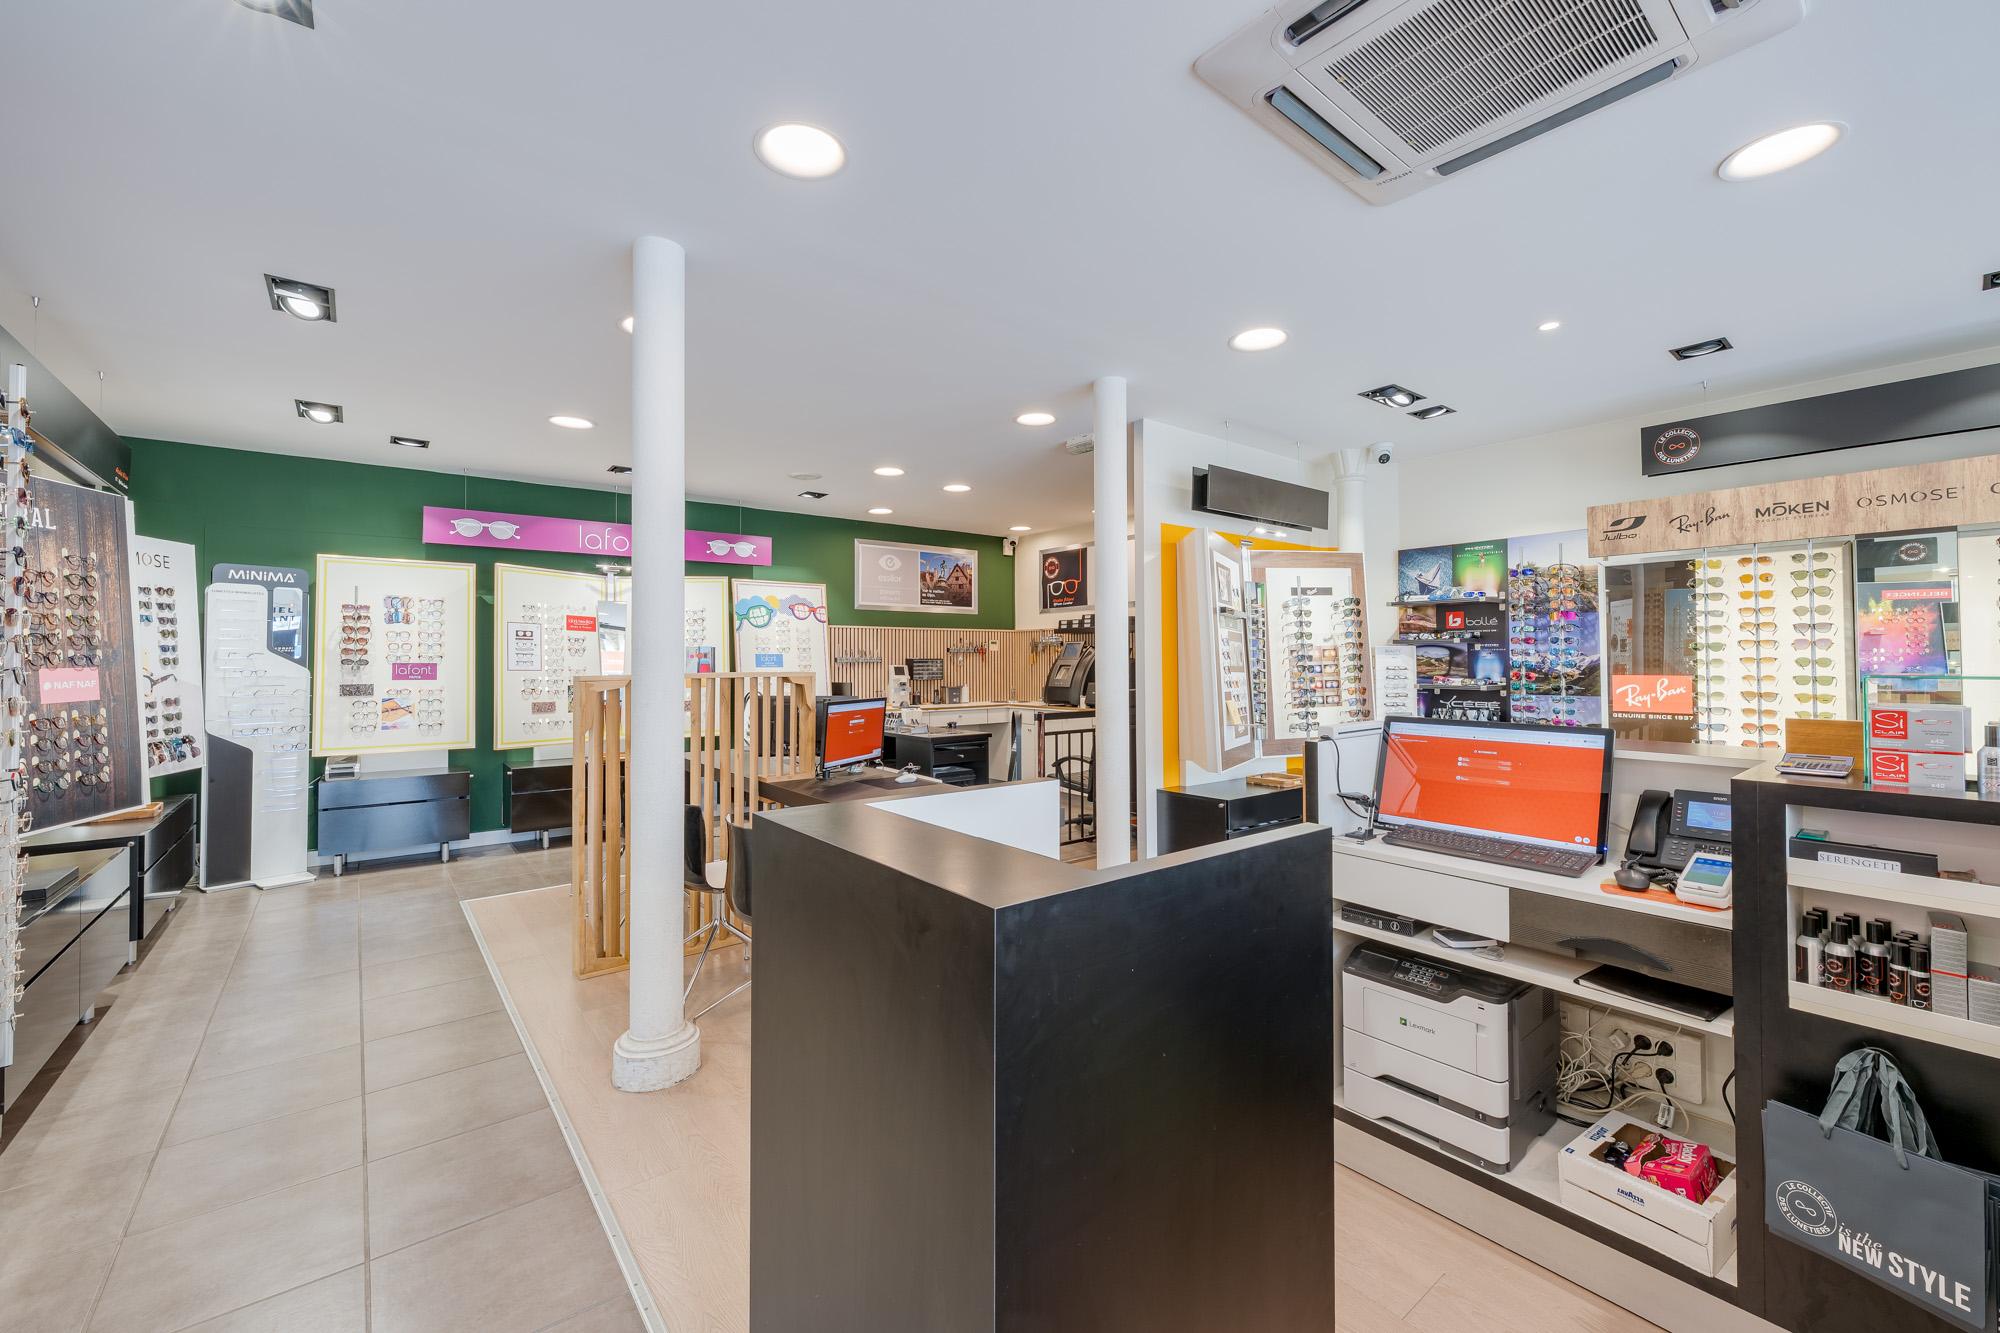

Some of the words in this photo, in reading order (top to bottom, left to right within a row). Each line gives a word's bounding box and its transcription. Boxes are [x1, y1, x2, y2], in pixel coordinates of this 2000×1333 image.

[1658, 436, 1666, 444] LE
[1665, 429, 1697, 439] COLLECTIF
[1657, 451, 1667, 461] DES
[1666, 446, 1698, 463] LUNETIERS
[1857, 487, 1958, 508] OSMOSE
[1669, 506, 1730, 533] Ray-Ban
[1600, 532, 1638, 542] Julbo
[1465, 616, 1498, 626] bollé
[395, 663, 433, 675] lafont
[1615, 678, 1687, 709] Ray-Ban
[1874, 712, 1905, 729] Si
[1875, 755, 1905, 772] Si
[1819, 853, 1895, 871] SERENGETI
[1409, 1021, 1437, 1036] Lexmark
[1677, 1142, 1698, 1164] Daddy
[1785, 1182, 1797, 1191] LE
[1796, 1183, 1835, 1219] COLLECTIF
[1778, 1195, 1789, 1213] DES
[1786, 1212, 1831, 1235] LUNETIERS
[1838, 1222, 1852, 1238] is
[1855, 1231, 1883, 1251] the
[1838, 1232, 1883, 1269] NEW
[1887, 1251, 1972, 1313] STYLE
